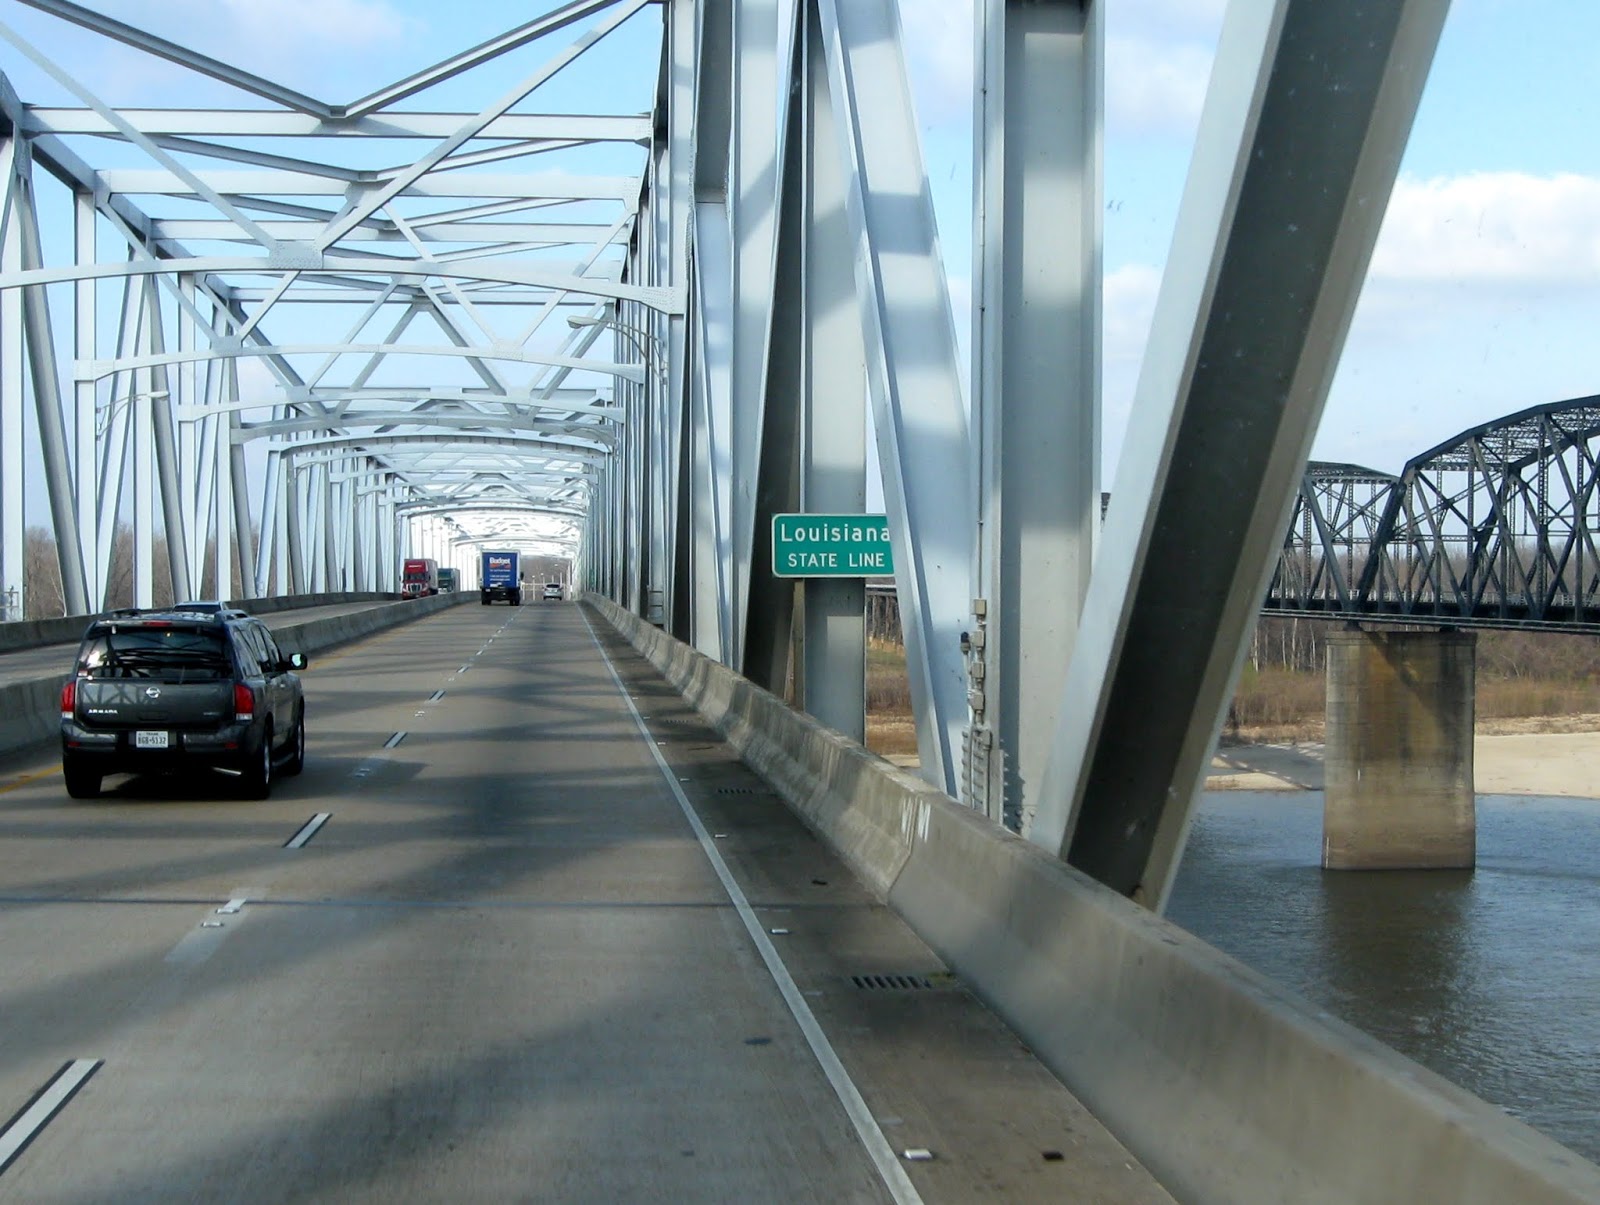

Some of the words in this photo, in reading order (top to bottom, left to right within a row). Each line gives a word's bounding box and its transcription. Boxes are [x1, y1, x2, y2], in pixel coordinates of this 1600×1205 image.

[781, 523, 890, 542] Louisiana
[489, 556, 511, 565] Budget
[788, 553, 837, 567] STATE
[849, 553, 885, 567] LINE
